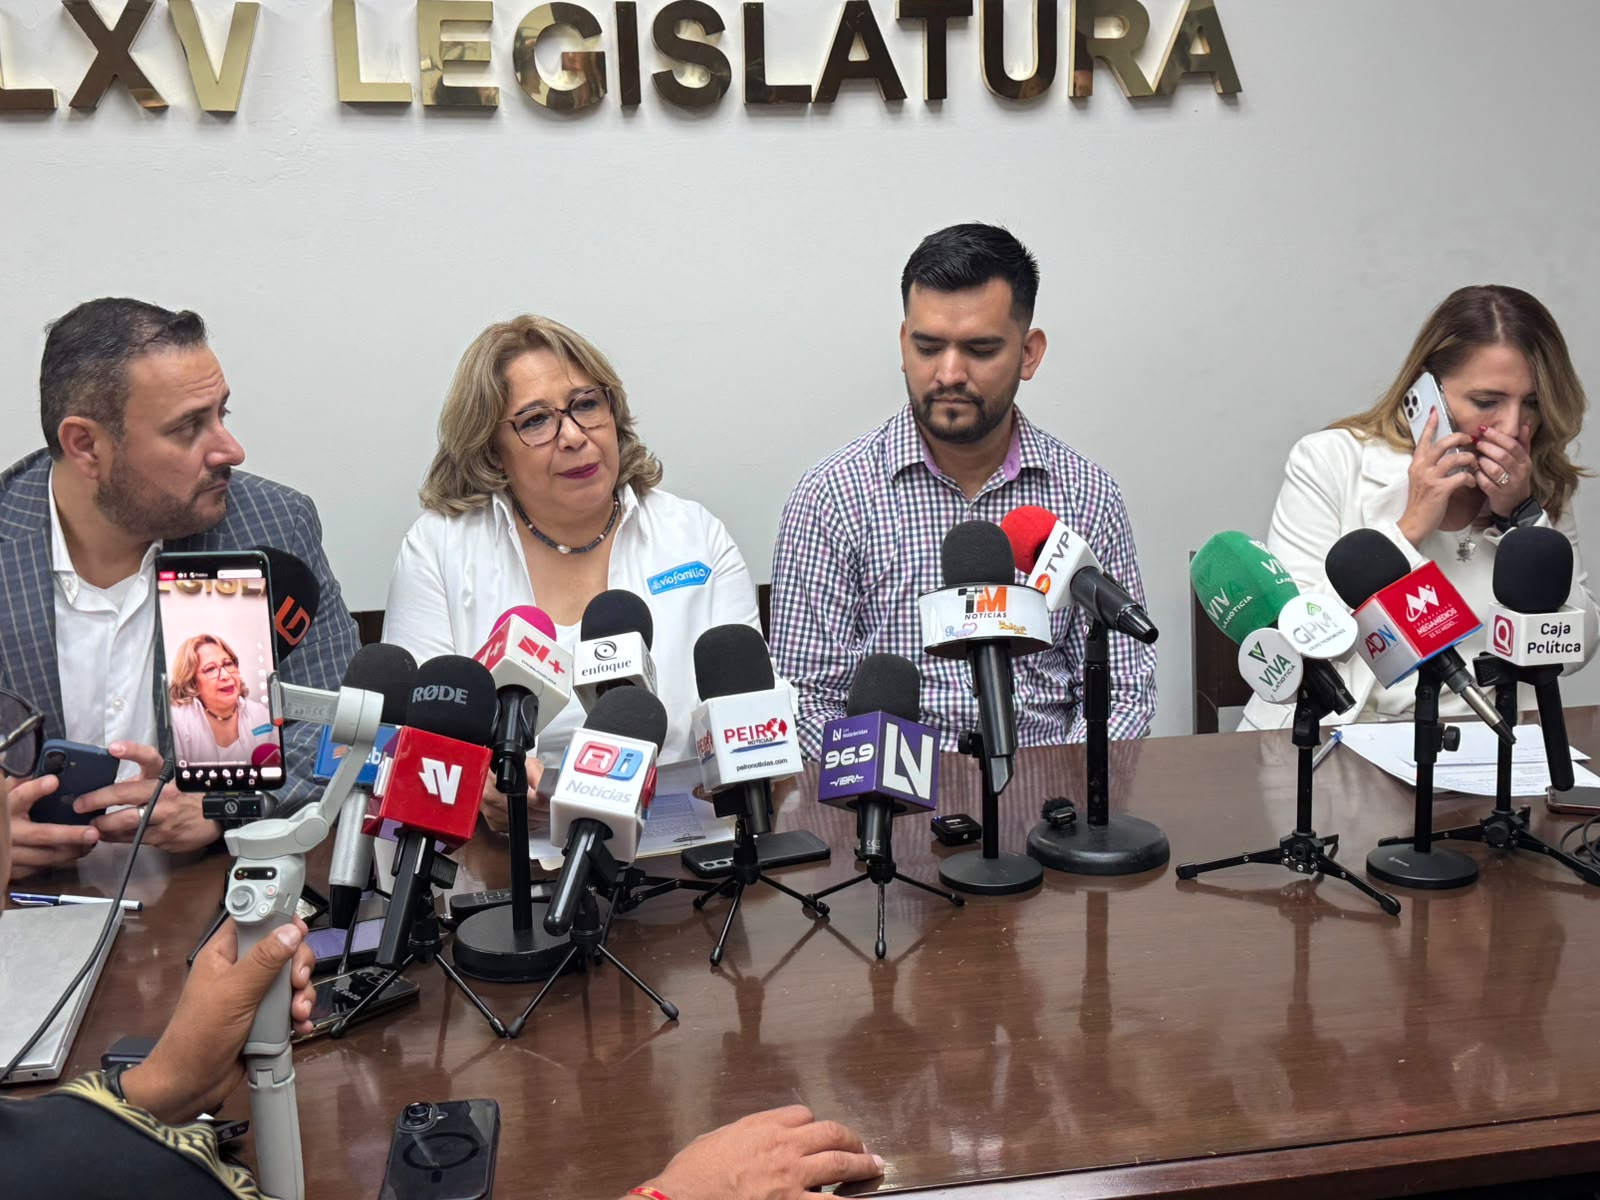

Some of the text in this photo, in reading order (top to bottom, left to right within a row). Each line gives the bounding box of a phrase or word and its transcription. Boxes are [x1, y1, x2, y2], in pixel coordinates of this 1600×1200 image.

[332, 0, 1243, 113] LEGISLATURA
[1044, 531, 1070, 573] TVP
[964, 612, 1008, 620] NOTICIAS
[1416, 607, 1458, 635] MEGAMEDIOS
[1540, 621, 1571, 638] Caja
[1365, 624, 1397, 659] ADN
[1527, 640, 1582, 655] Política
[581, 660, 632, 677] enfoque
[1259, 654, 1291, 687] VIVA
[412, 684, 469, 704] RØDE
[747, 737, 773, 745] NOTICIAS
[736, 758, 788, 772] peironoticias.com
[825, 743, 875, 769] 96.9
[565, 779, 633, 803] Noticias
